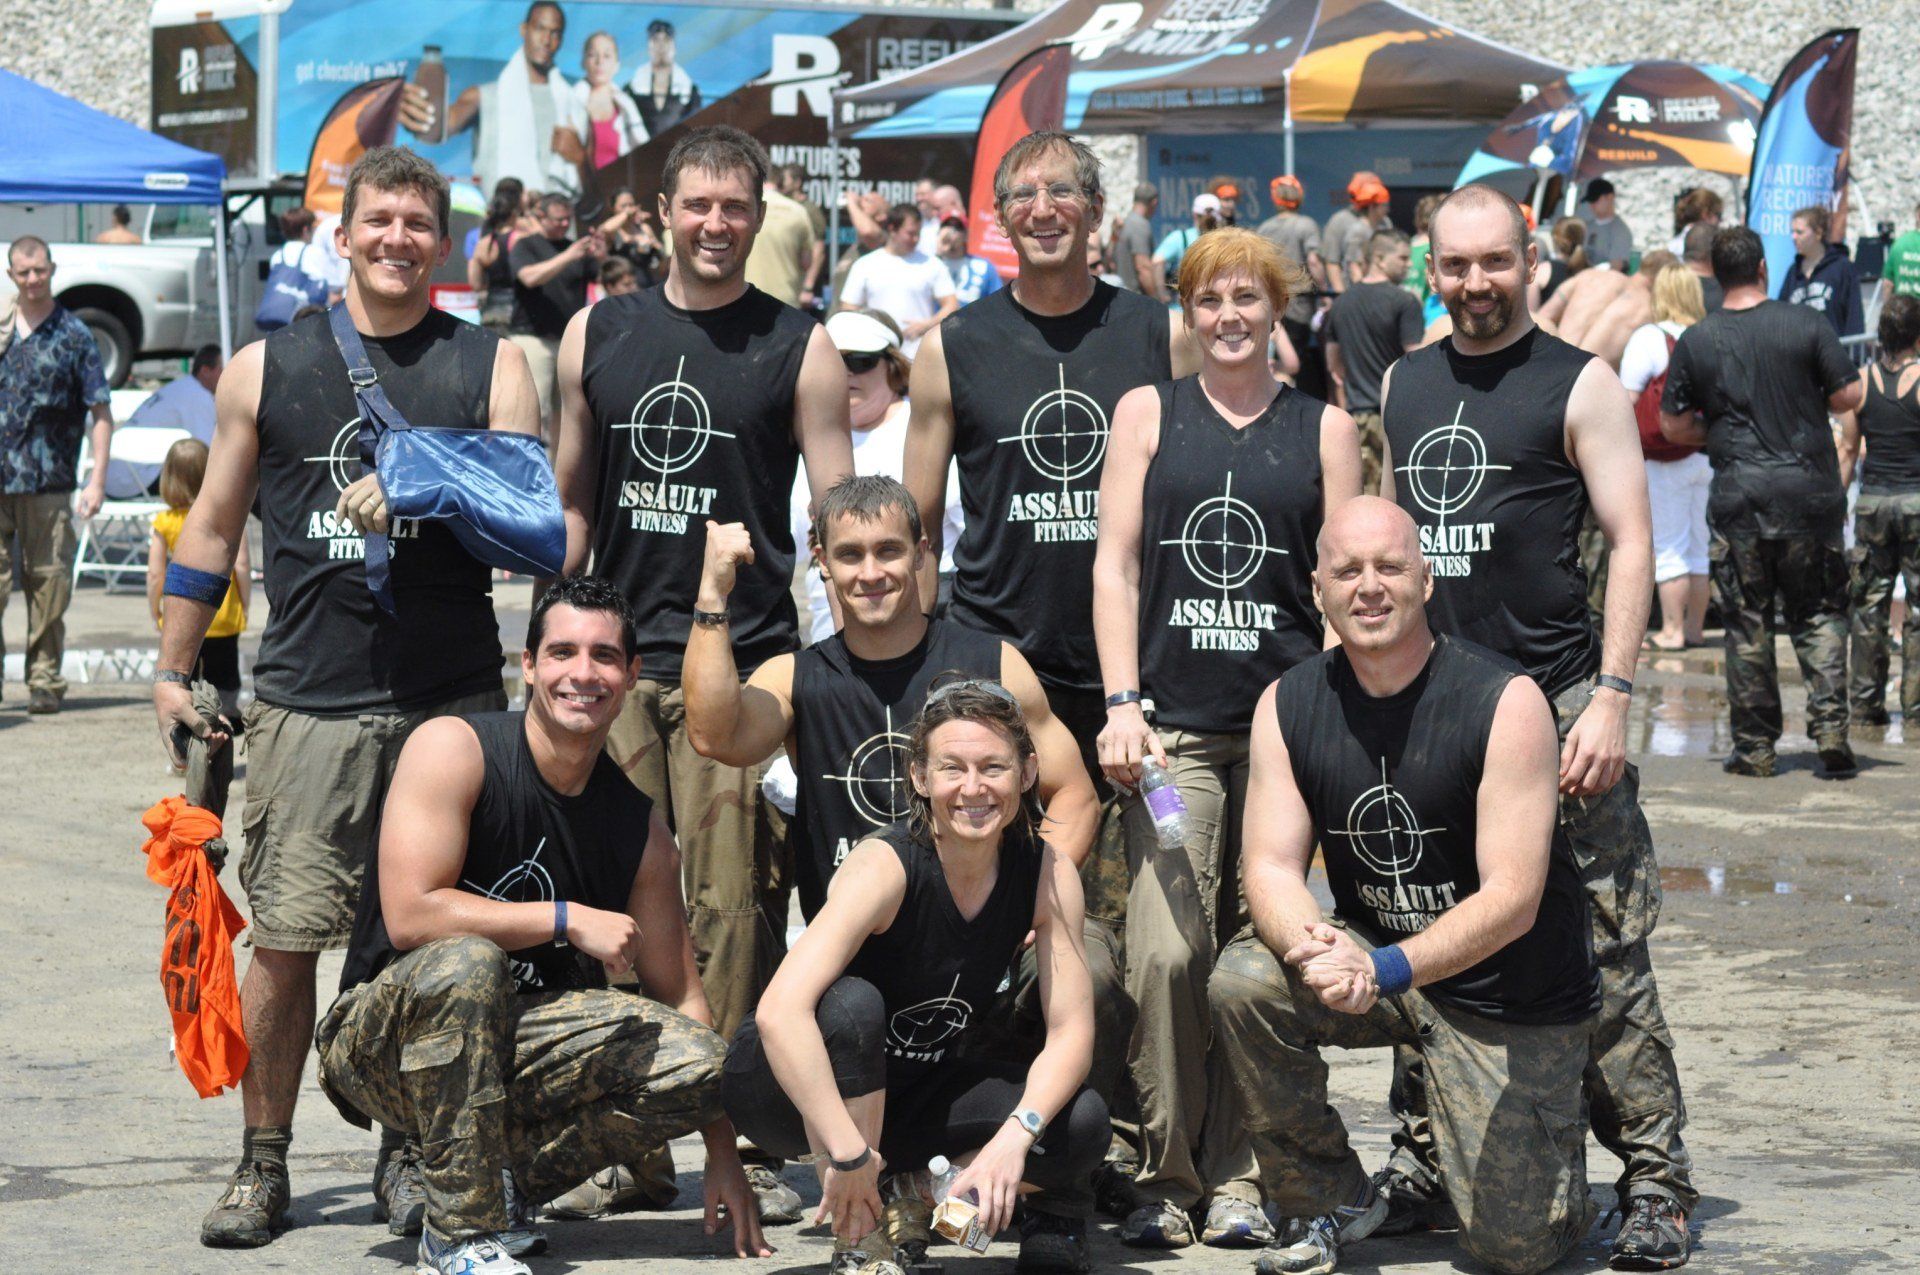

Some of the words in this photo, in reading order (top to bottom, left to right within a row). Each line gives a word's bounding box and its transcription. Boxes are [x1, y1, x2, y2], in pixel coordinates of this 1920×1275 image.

[764, 33, 846, 118] R
[1598, 149, 1658, 161] REBUILD
[1760, 214, 1792, 236] DRI
[1006, 490, 1100, 522] ASSAU
[306, 510, 419, 539] ASSLT
[1034, 519, 1098, 543] FITNESS
[328, 537, 396, 560] FITNS
[1416, 522, 1495, 554] SAULT
[1168, 598, 1278, 631] ASSAULT
[1191, 628, 1260, 652] FITNESS
